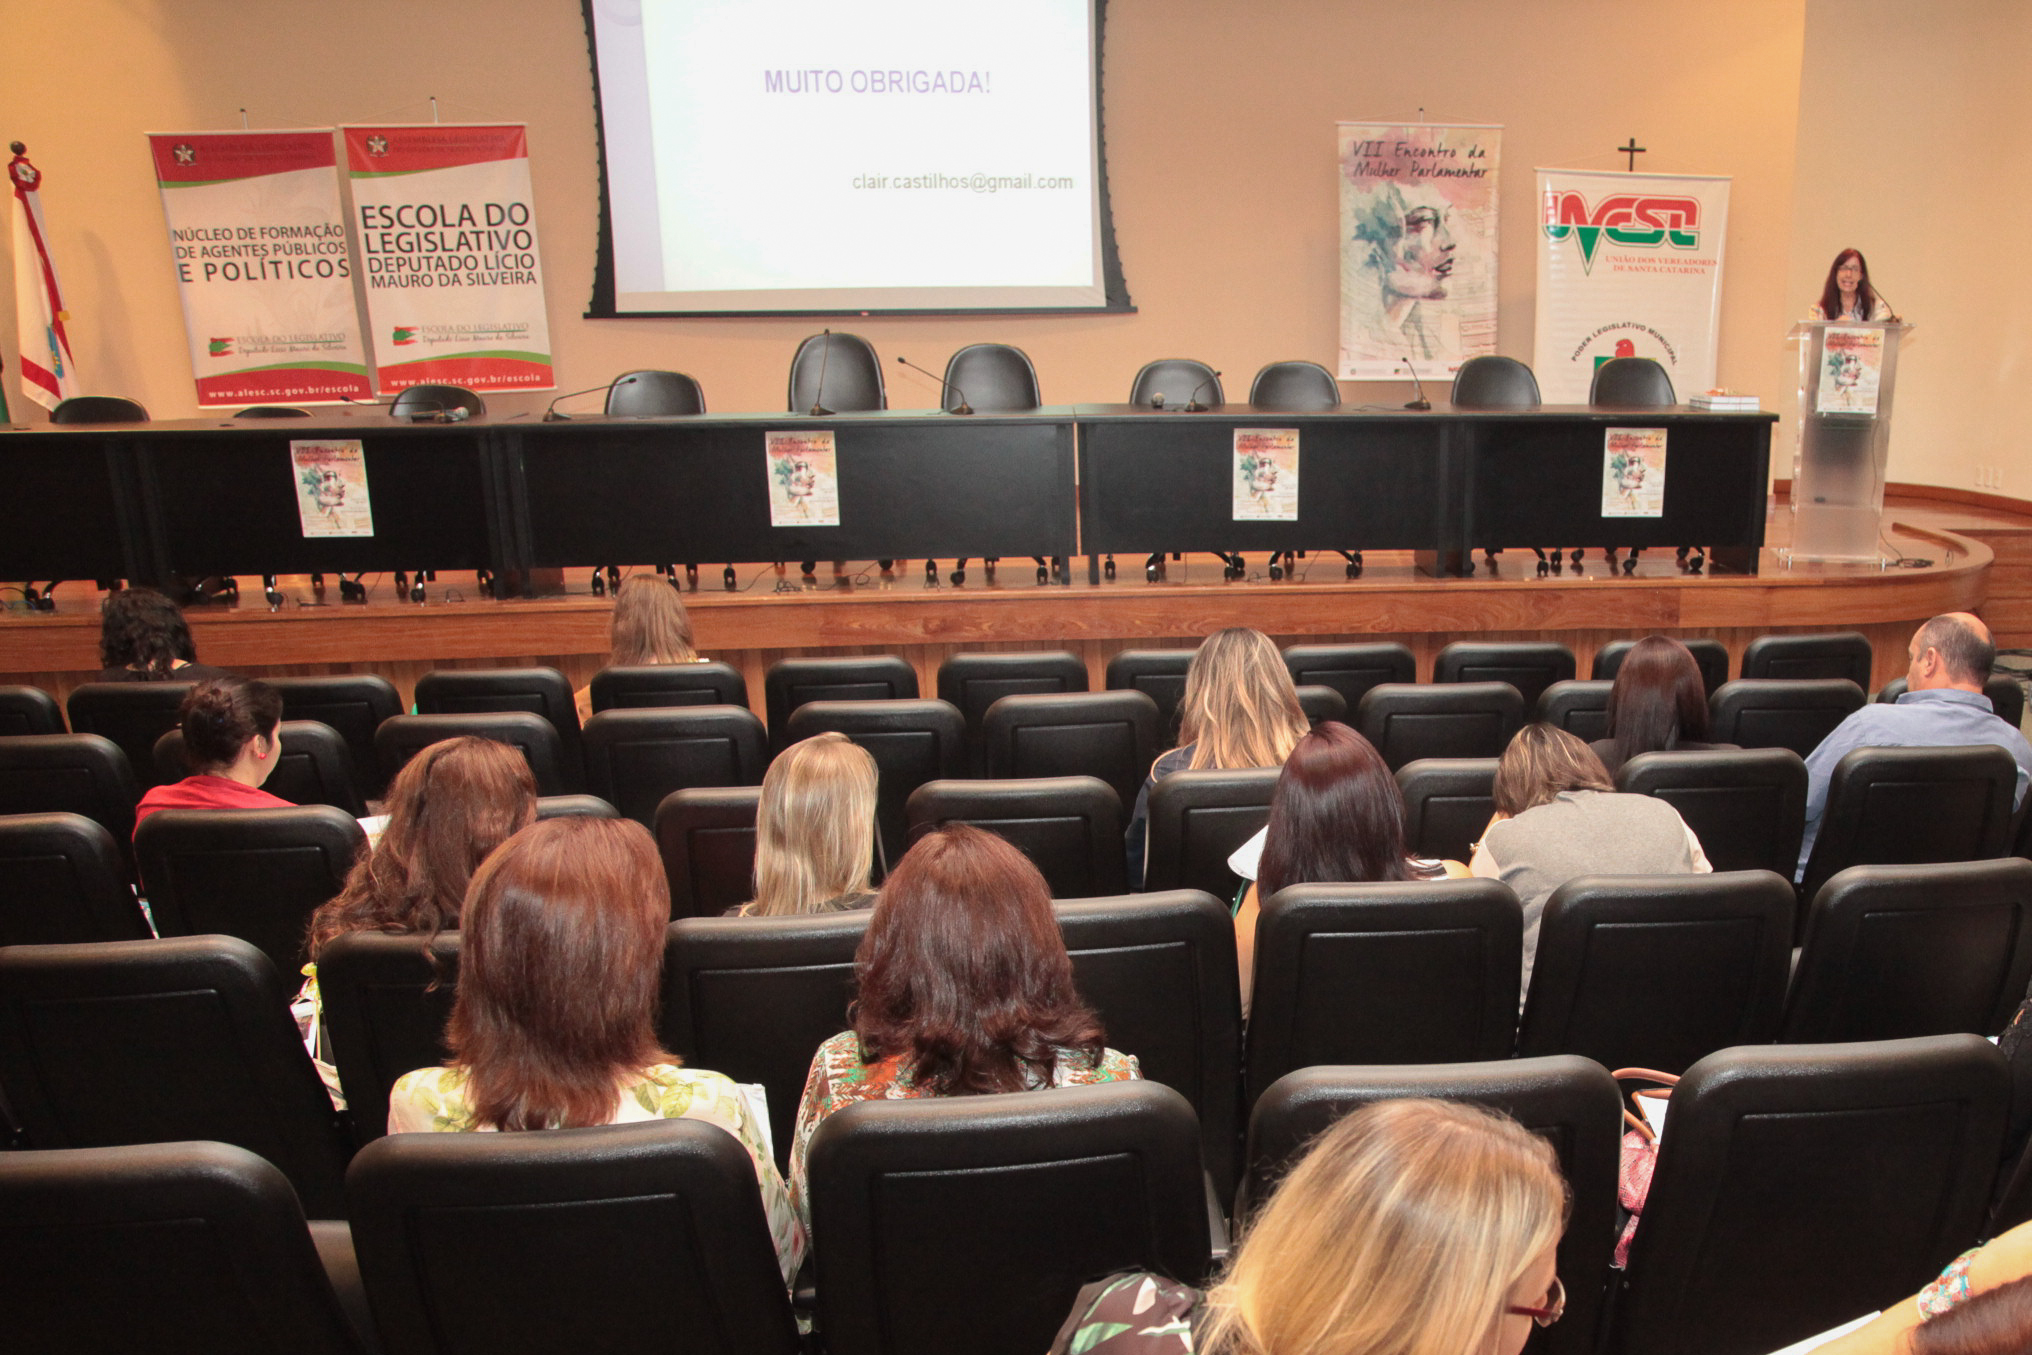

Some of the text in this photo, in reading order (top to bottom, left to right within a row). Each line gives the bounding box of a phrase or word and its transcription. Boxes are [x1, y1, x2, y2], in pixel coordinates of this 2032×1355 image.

[764, 69, 991, 94] MUITO OBRIGADA!
[1353, 140, 1486, 158] VII Encontro da
[1354, 160, 1488, 178] Mulher Parlamentar
[852, 172, 1074, 193] clair.castilhos@gmail.com
[361, 202, 530, 229] ESCOLA DO
[172, 222, 344, 242] NÚCLEO DE FORMAÇÃO
[364, 229, 532, 254] LEGISLATIVO
[175, 240, 347, 259] DE AGENTES PÚBLICOS
[178, 256, 350, 283] E POLÍTICOS
[368, 251, 535, 273] DEPUTADO LÍCIO
[1605, 255, 1718, 267] UNIÃO DOS VEREADORES
[1613, 264, 1706, 275] DE SANTA CATARINA
[371, 271, 537, 289] MAURO DA SILVEIRA
[473, 322, 529, 331] LEGISLATIVO
[1571, 321, 1678, 366] PODER LEGISLATIVO MUNICIPAL
[390, 374, 541, 387] www.alesc.sc.gov.br/escola
[208, 385, 359, 398] www.alesc.sc.gov.br/escola
